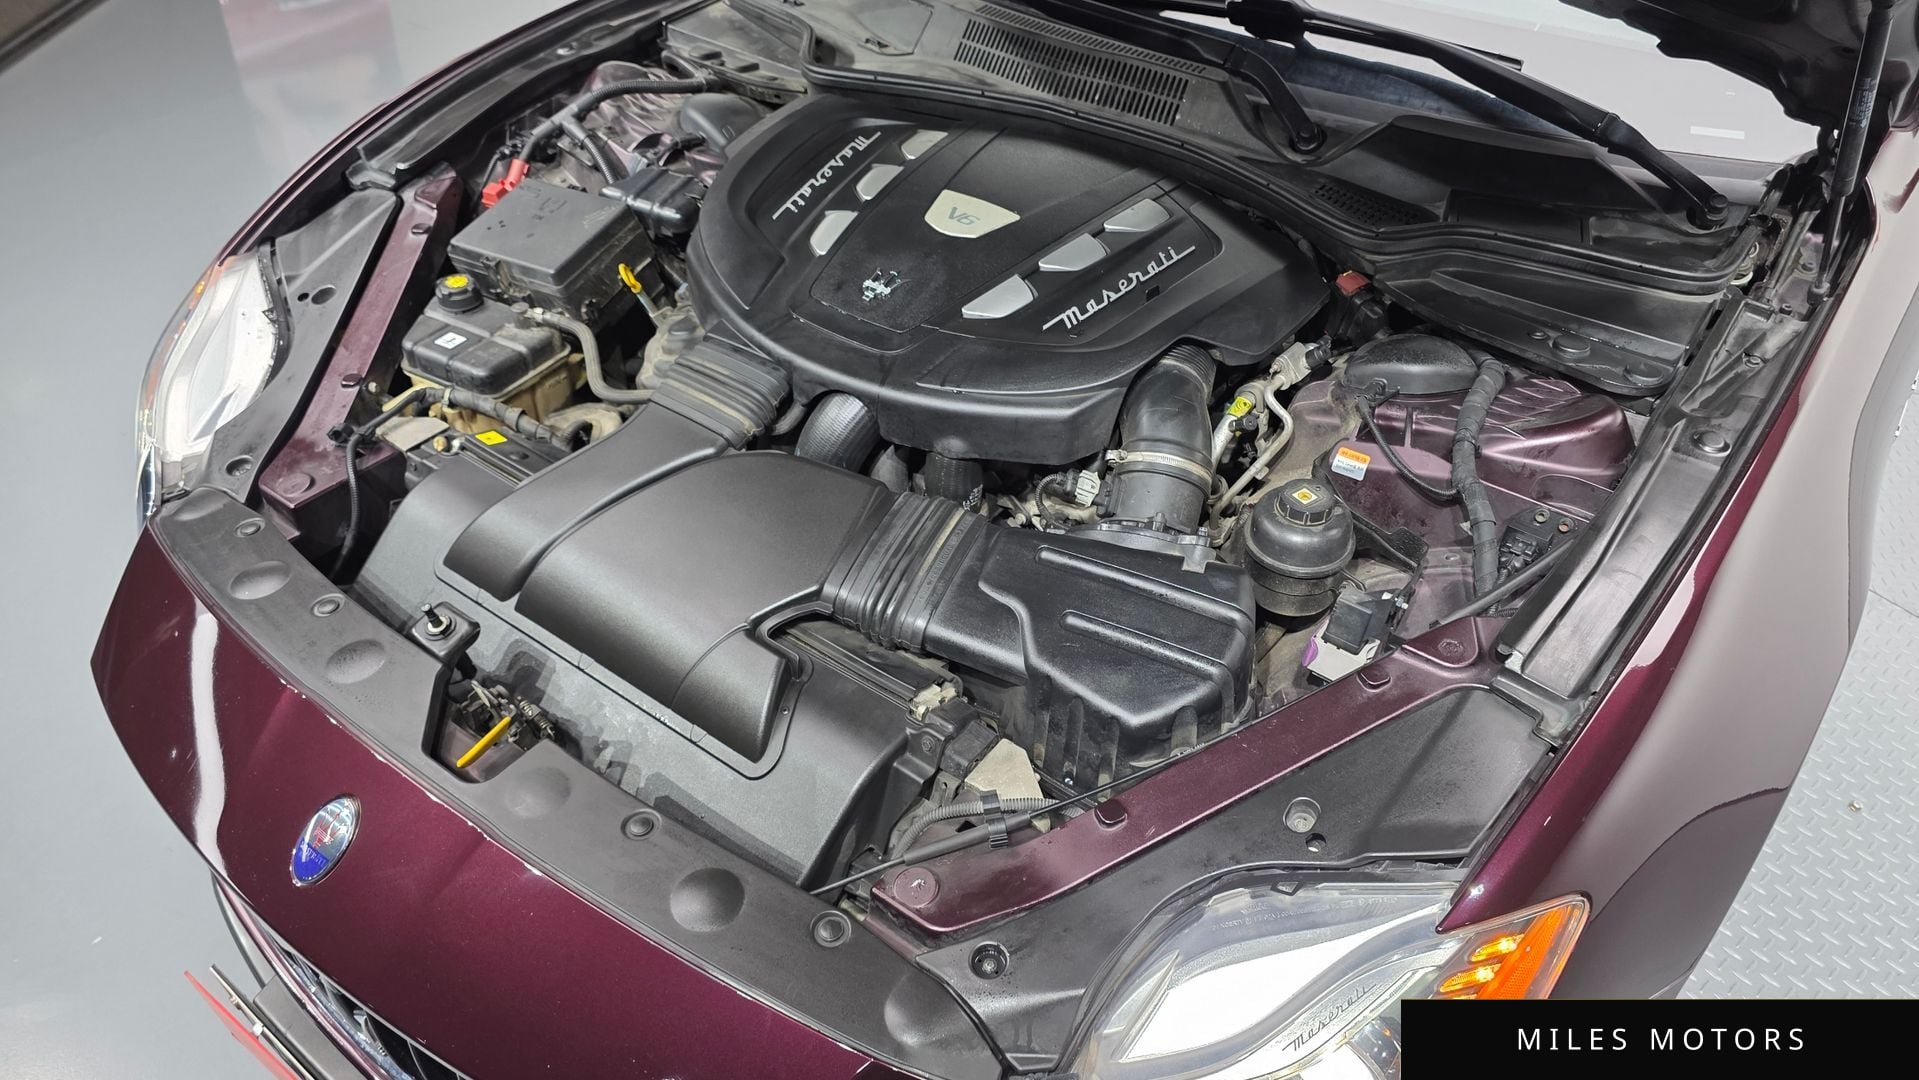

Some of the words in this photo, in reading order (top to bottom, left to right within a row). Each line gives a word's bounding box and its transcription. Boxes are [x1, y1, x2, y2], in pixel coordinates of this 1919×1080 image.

[772, 131, 882, 220] Maserati
[948, 206, 981, 225] V6
[1042, 246, 1196, 331] Maserati
[1281, 983, 1377, 1052] Maserati
